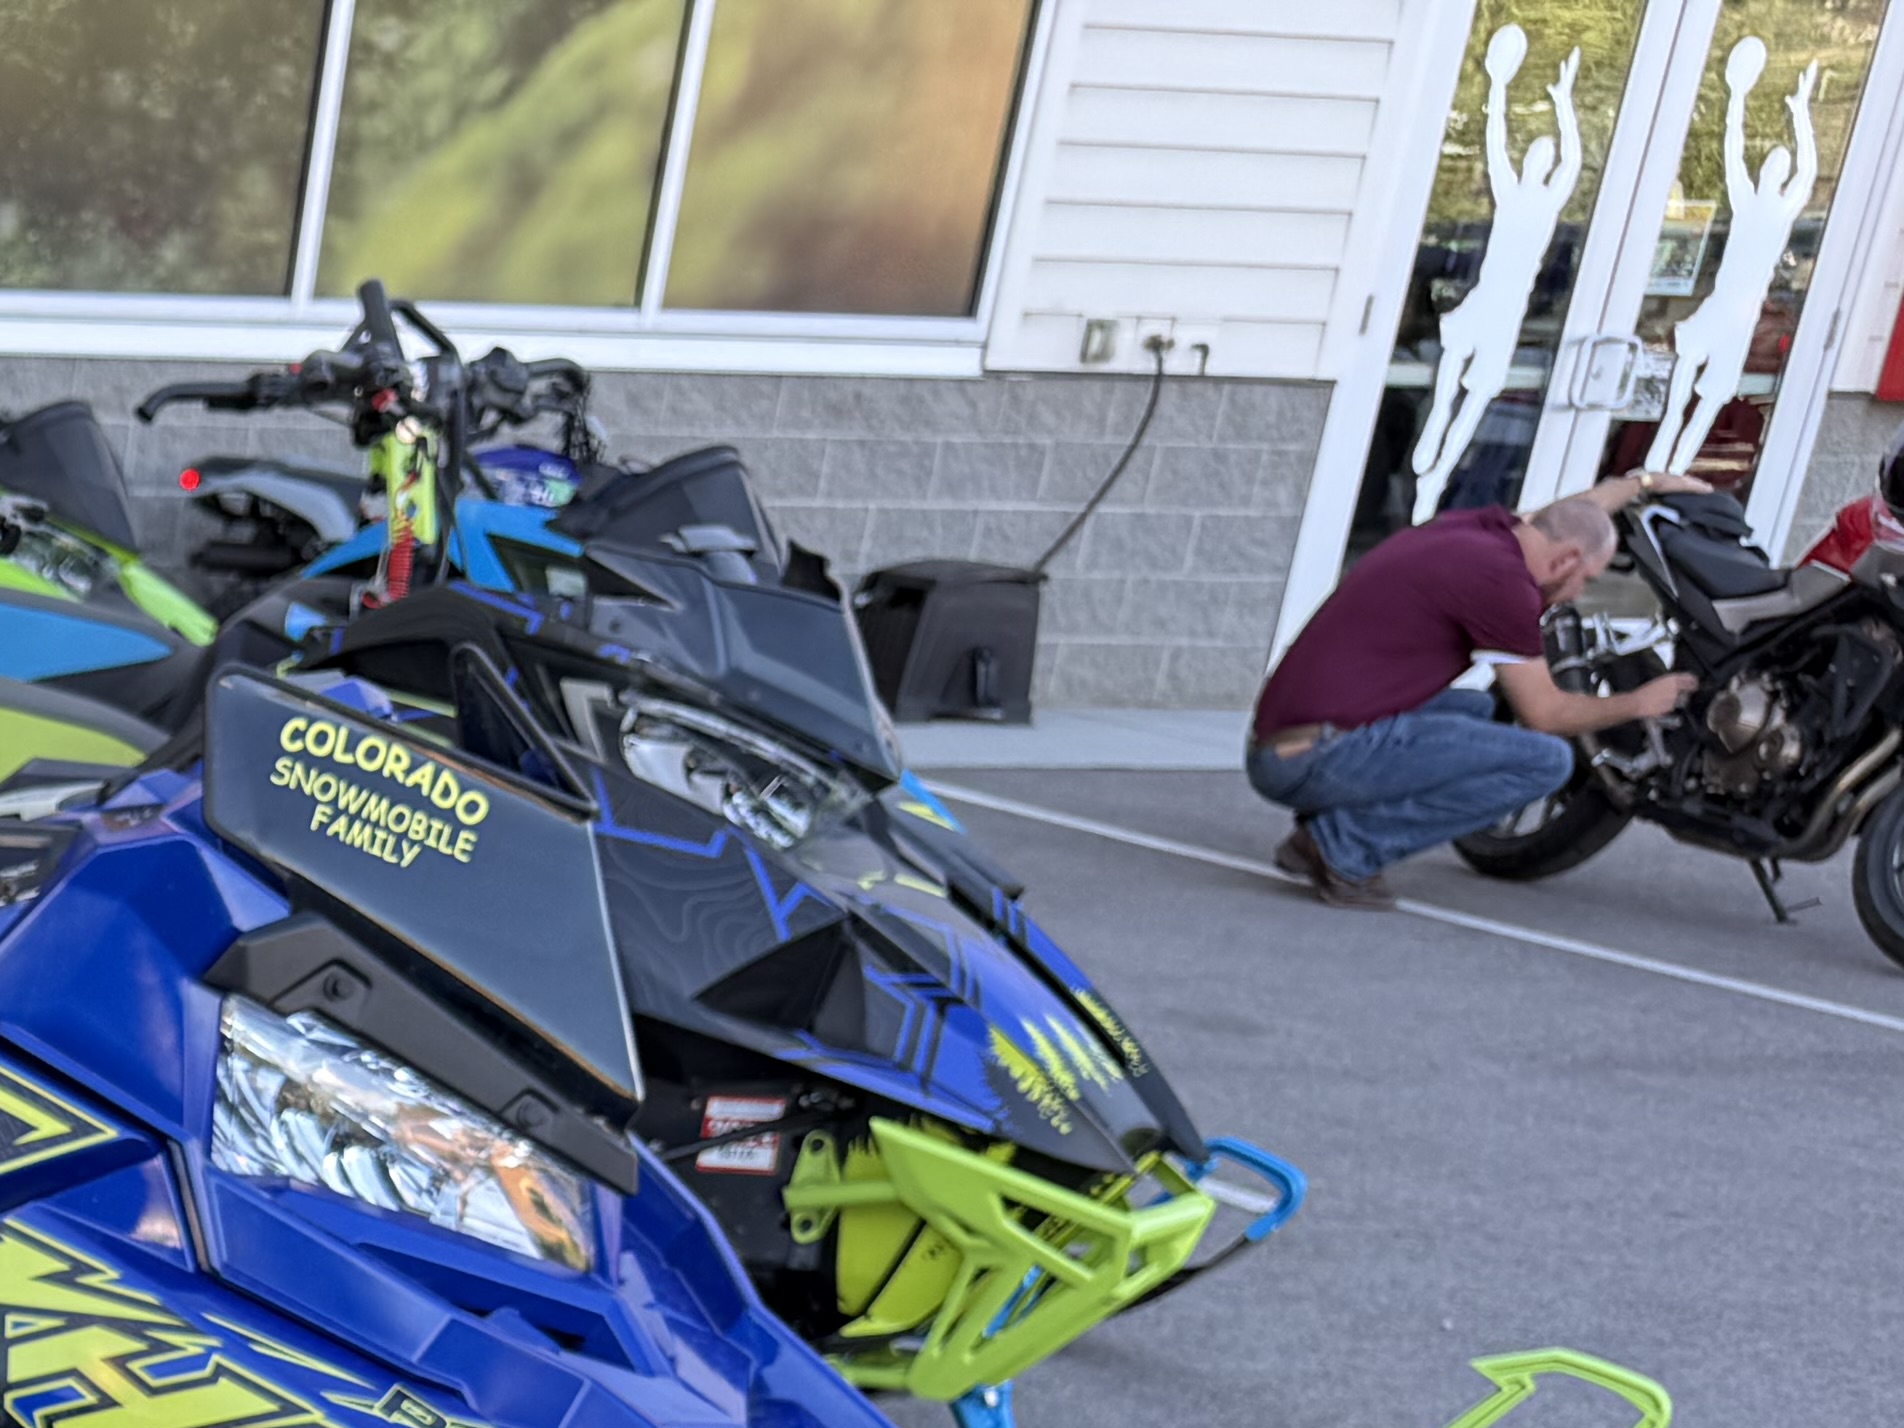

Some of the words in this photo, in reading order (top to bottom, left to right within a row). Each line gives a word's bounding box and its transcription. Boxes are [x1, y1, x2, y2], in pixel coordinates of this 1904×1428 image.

[269, 755, 479, 863] SNOWMOBILE
[279, 716, 490, 826] COLORADO
[309, 803, 423, 869] FAMILY
